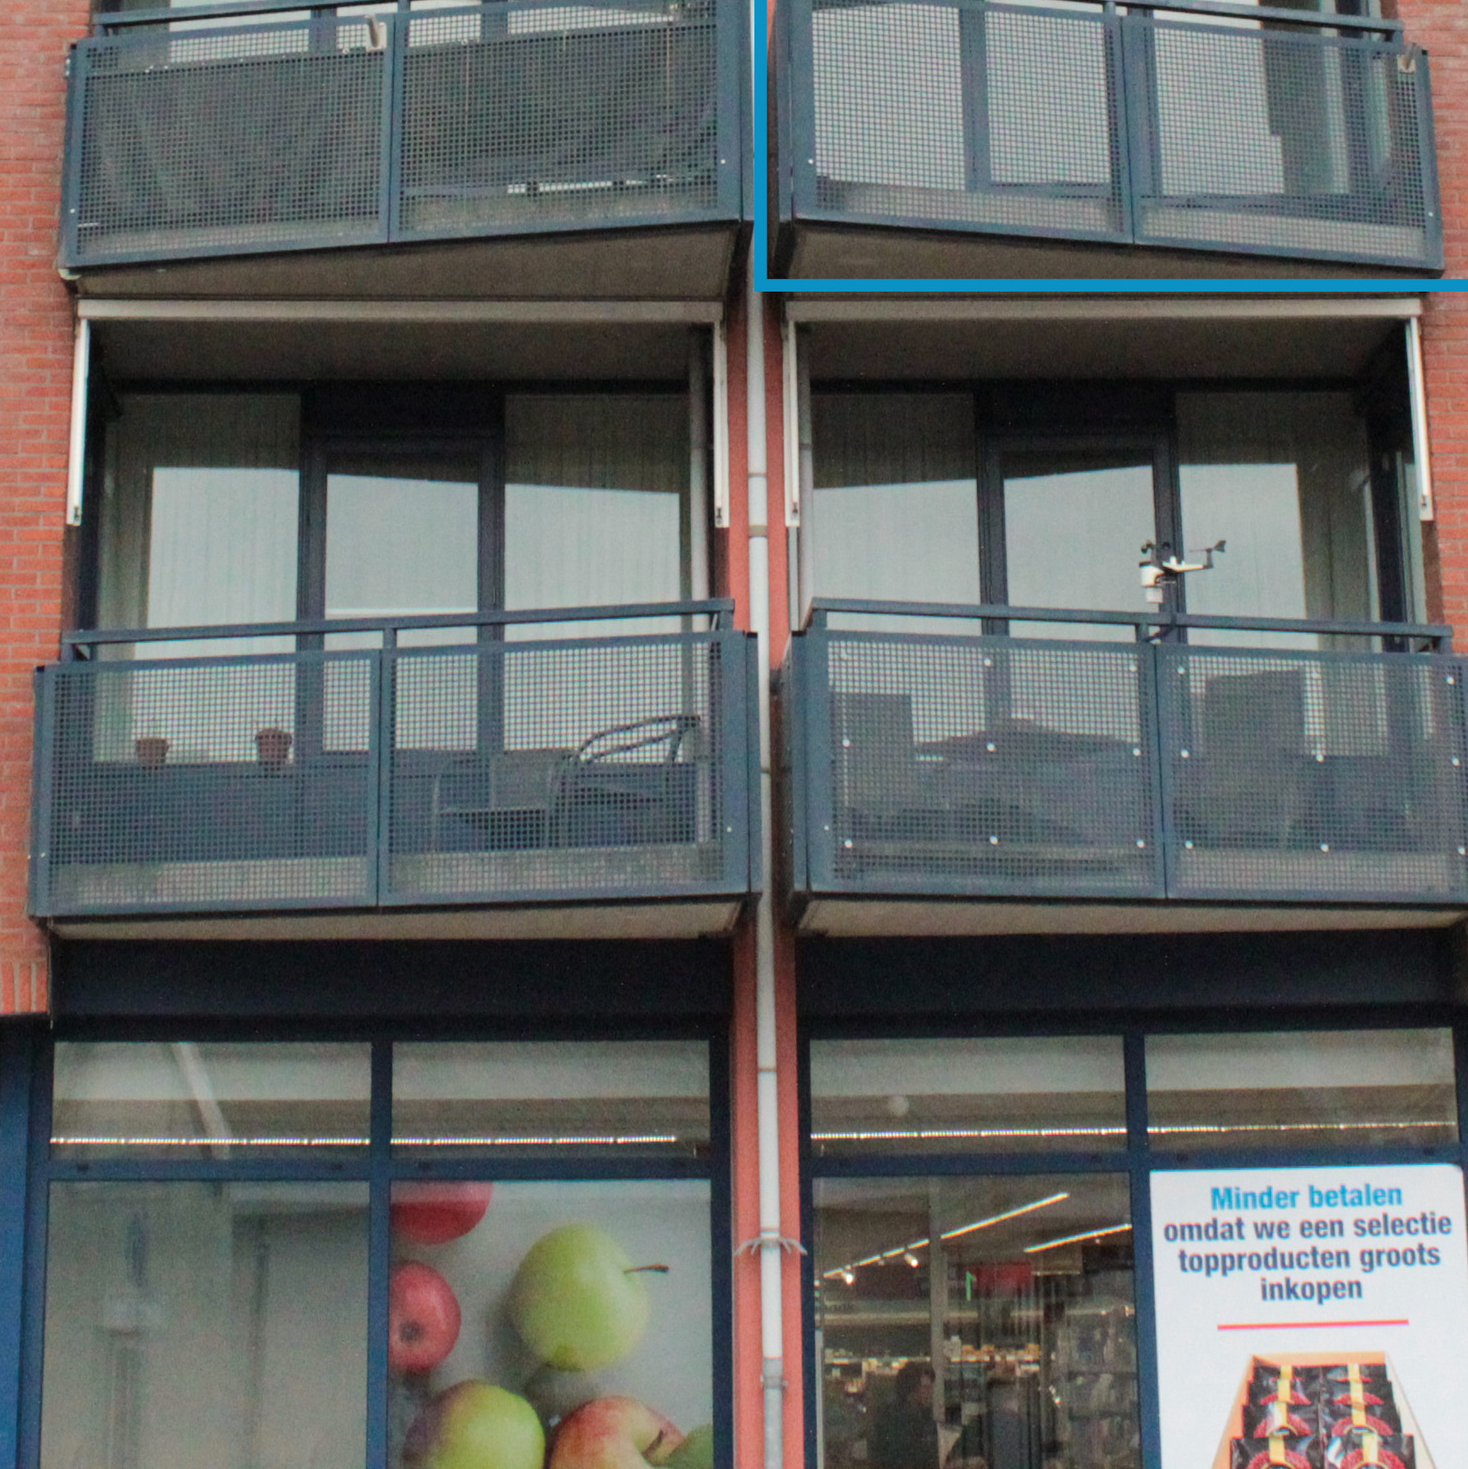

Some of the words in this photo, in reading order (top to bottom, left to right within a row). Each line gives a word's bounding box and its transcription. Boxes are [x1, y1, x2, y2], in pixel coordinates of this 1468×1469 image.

[1211, 1186, 1300, 1210] Minder
[1309, 1183, 1403, 1208] betalen
[1163, 1217, 1245, 1242] omdat
[1253, 1221, 1291, 1239] we
[1299, 1219, 1345, 1239] een
[1353, 1212, 1452, 1238] selectie
[1179, 1246, 1351, 1277] topproducten
[1359, 1243, 1441, 1273] groots
[1261, 1277, 1363, 1305] inkopen
